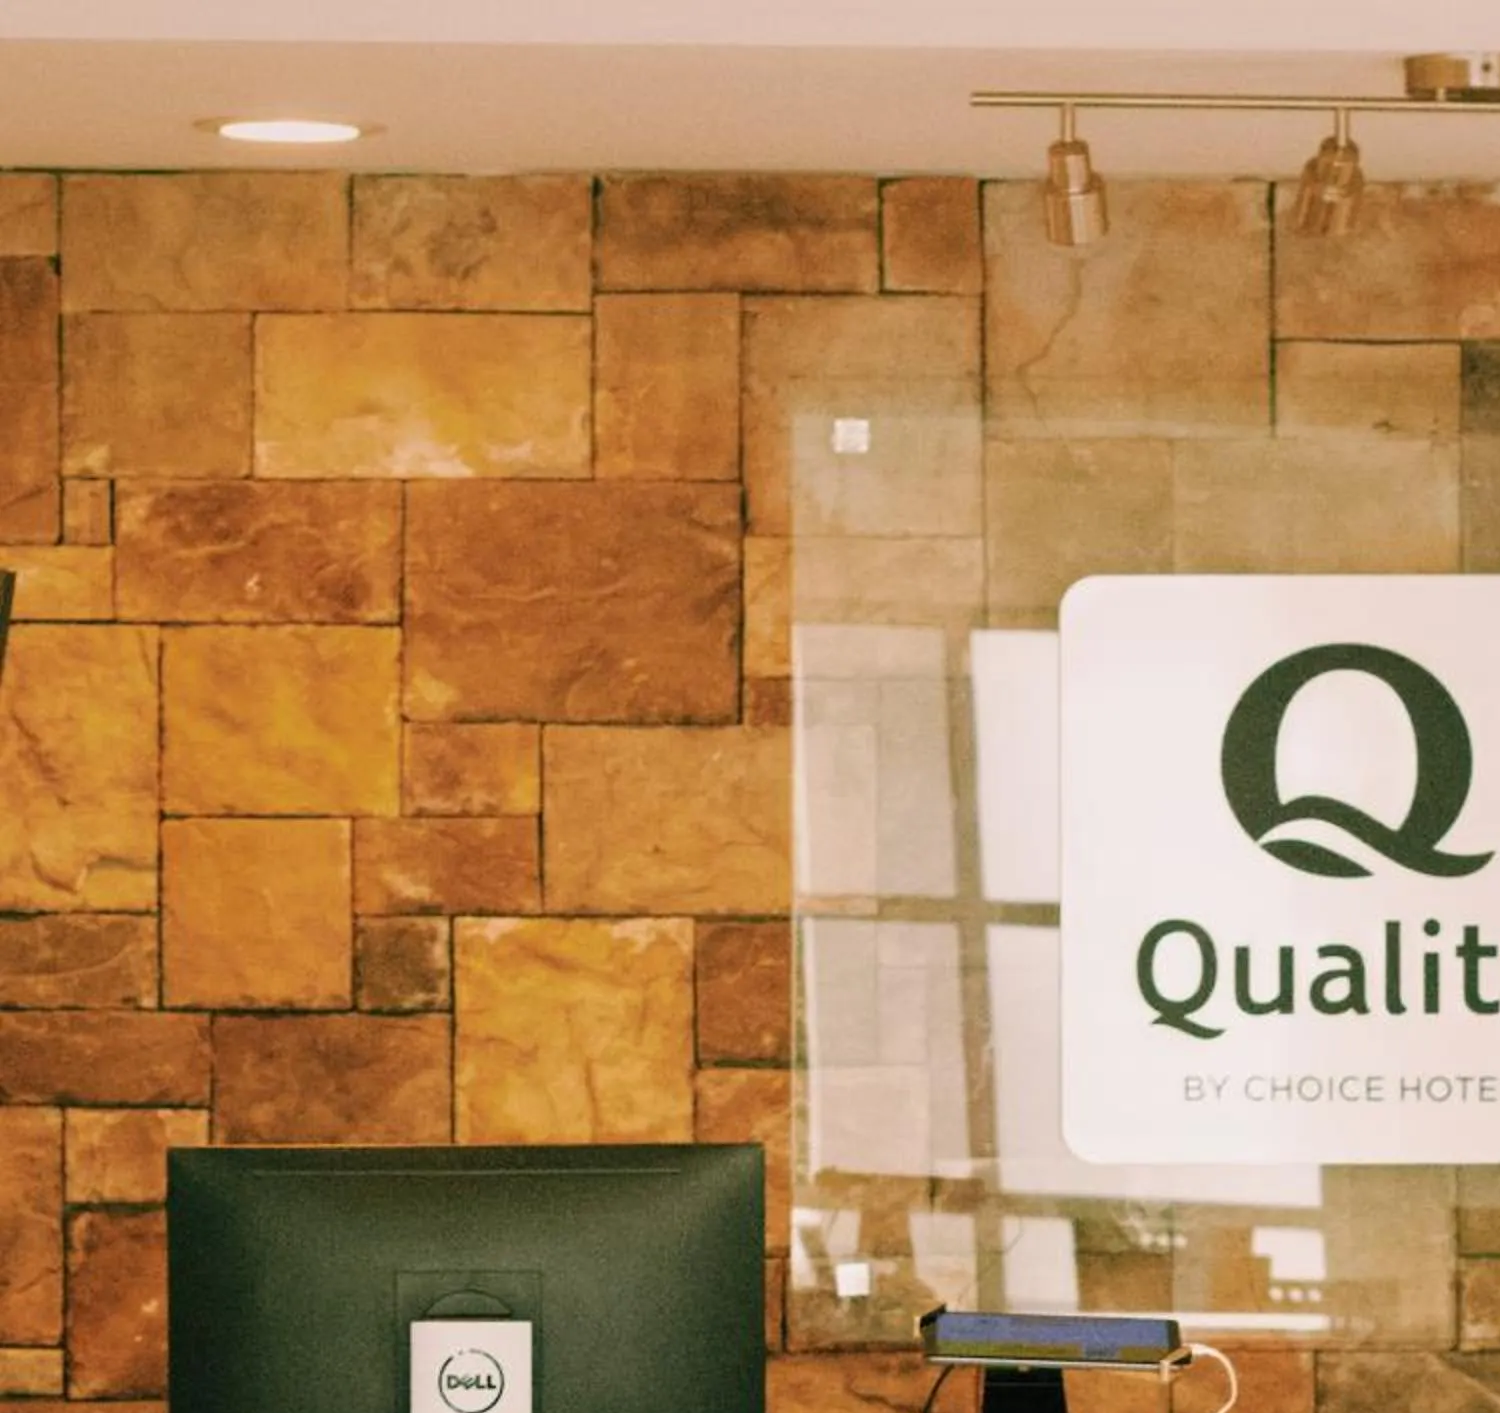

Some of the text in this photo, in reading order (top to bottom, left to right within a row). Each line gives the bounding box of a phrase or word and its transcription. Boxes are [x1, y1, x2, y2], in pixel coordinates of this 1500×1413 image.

[1220, 642, 1497, 878] Q
[1184, 1076, 1230, 1102] BY
[1244, 1075, 1384, 1102] CHOICE
[446, 1374, 497, 1390] DELL
